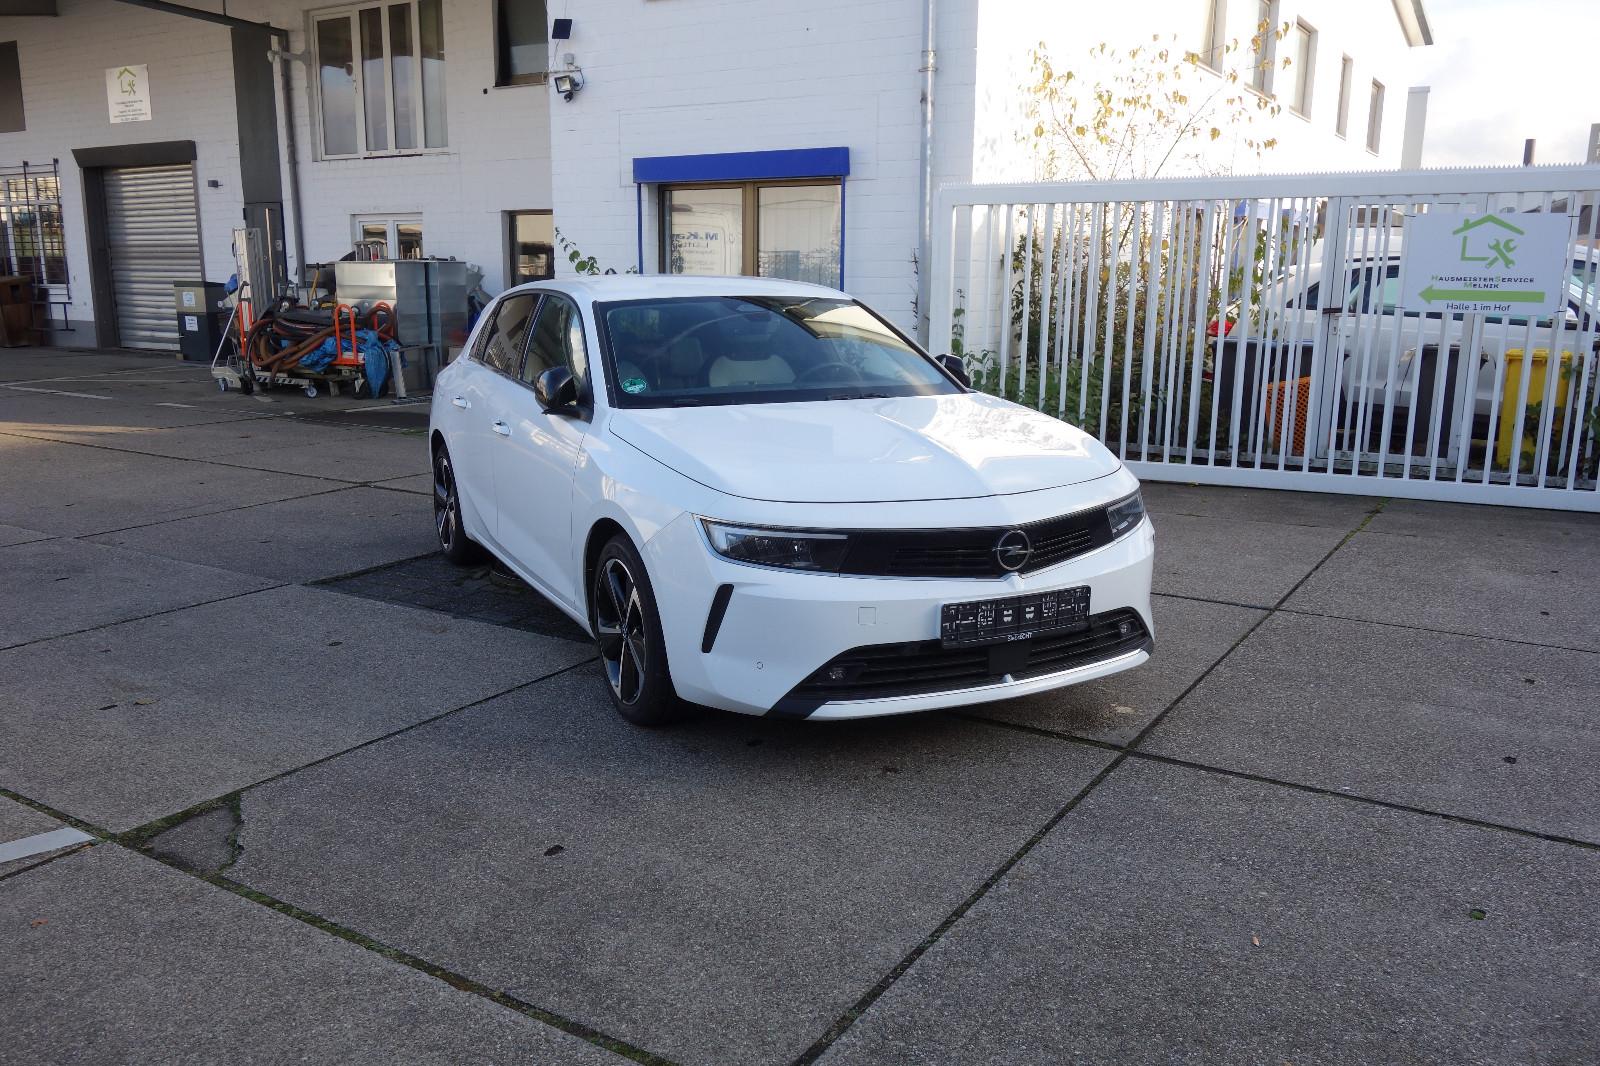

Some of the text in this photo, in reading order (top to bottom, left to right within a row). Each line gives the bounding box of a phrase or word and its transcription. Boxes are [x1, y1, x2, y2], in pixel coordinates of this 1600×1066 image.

[1431, 274, 1535, 283] HAUSMEISTERSERVICE
[1446, 303, 1469, 311] Halle
[1493, 304, 1512, 312] Hof
